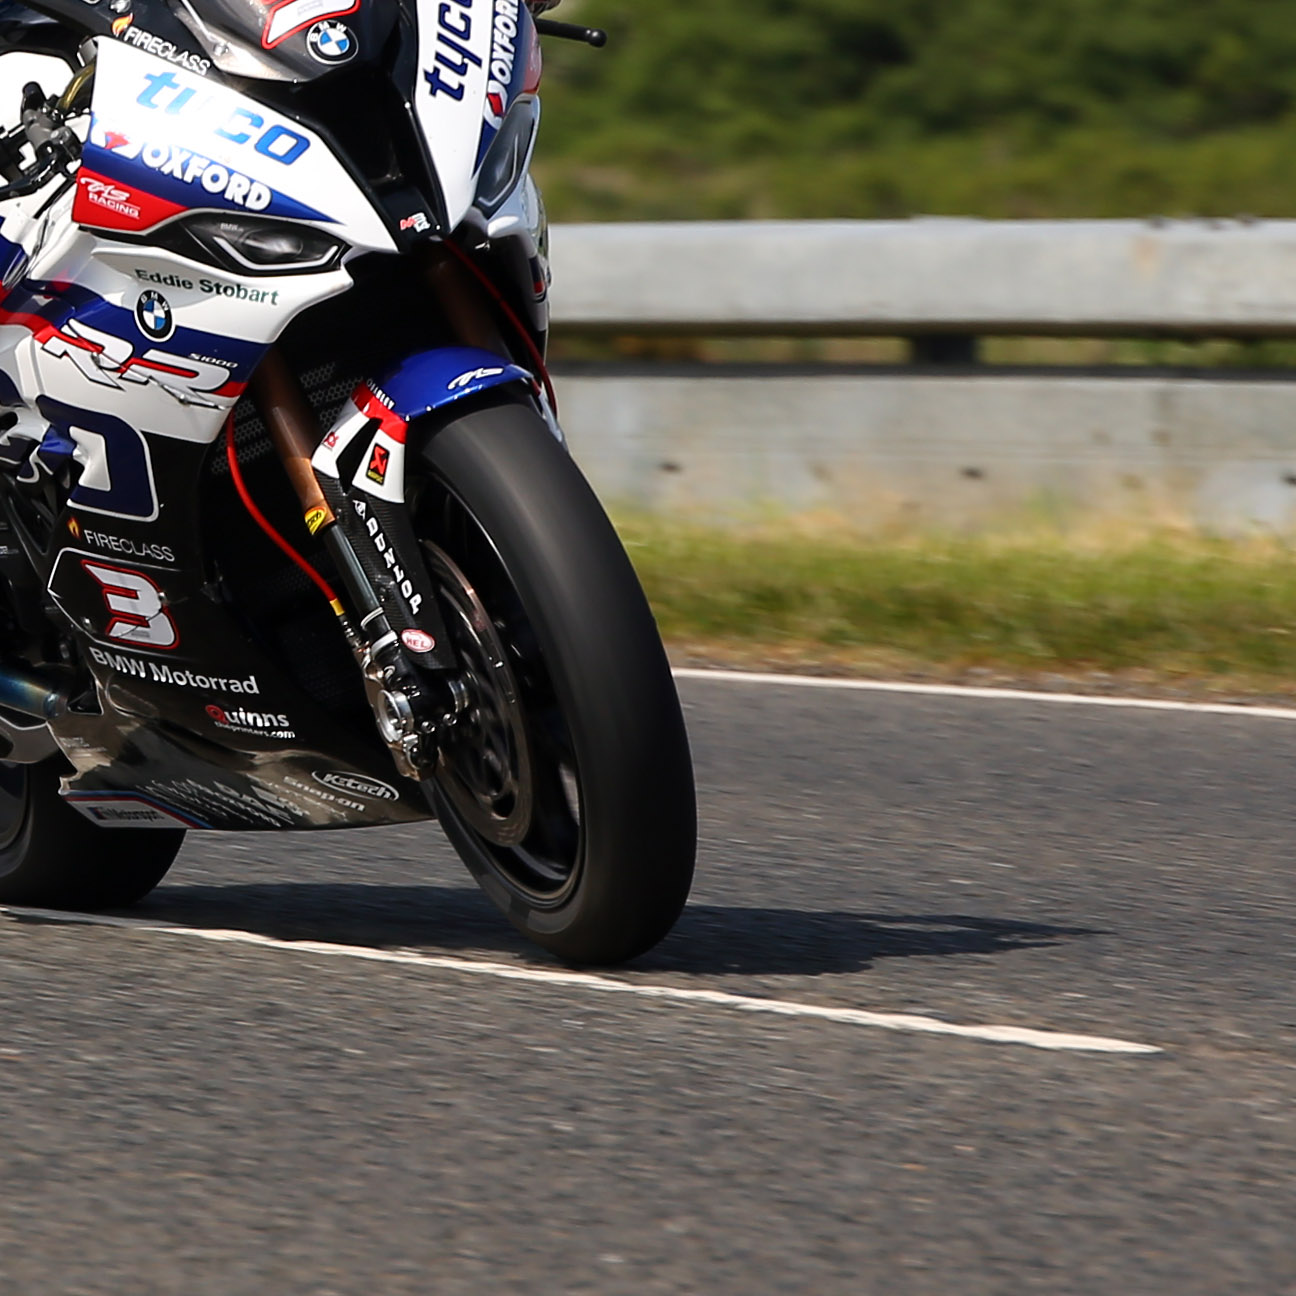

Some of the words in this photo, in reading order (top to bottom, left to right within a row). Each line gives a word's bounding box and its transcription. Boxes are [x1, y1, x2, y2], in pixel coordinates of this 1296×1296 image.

[123, 26, 211, 76] FIRECLASS
[142, 142, 272, 210] OXFORD
[88, 194, 140, 219] RACING
[135, 269, 193, 290] Eddie
[199, 278, 280, 305] Stobart
[42, 318, 230, 410] RR
[188, 352, 239, 369] S1000
[84, 529, 175, 562] FIRECLASS
[366, 517, 422, 615] DUNLOP
[81, 559, 180, 649] 3
[406, 637, 427, 648] HEL
[89, 647, 146, 678] BMW
[149, 662, 260, 694] Motorrad
[205, 705, 289, 727] Quinns
